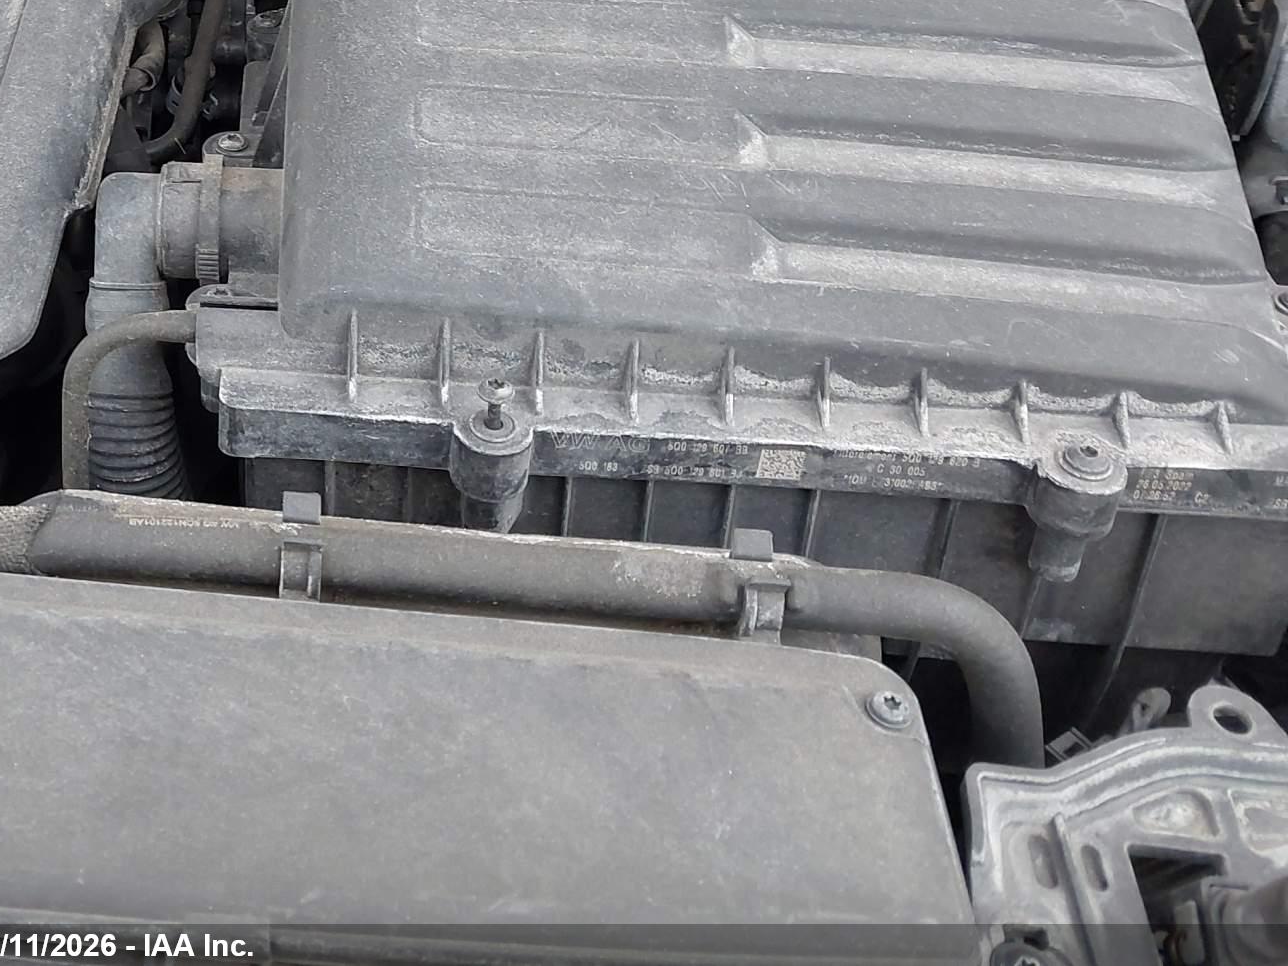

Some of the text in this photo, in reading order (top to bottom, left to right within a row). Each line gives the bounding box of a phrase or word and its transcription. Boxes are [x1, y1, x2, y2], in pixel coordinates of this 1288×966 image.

[550, 432, 651, 453] VW AG
[877, 463, 926, 477] C 30 005
